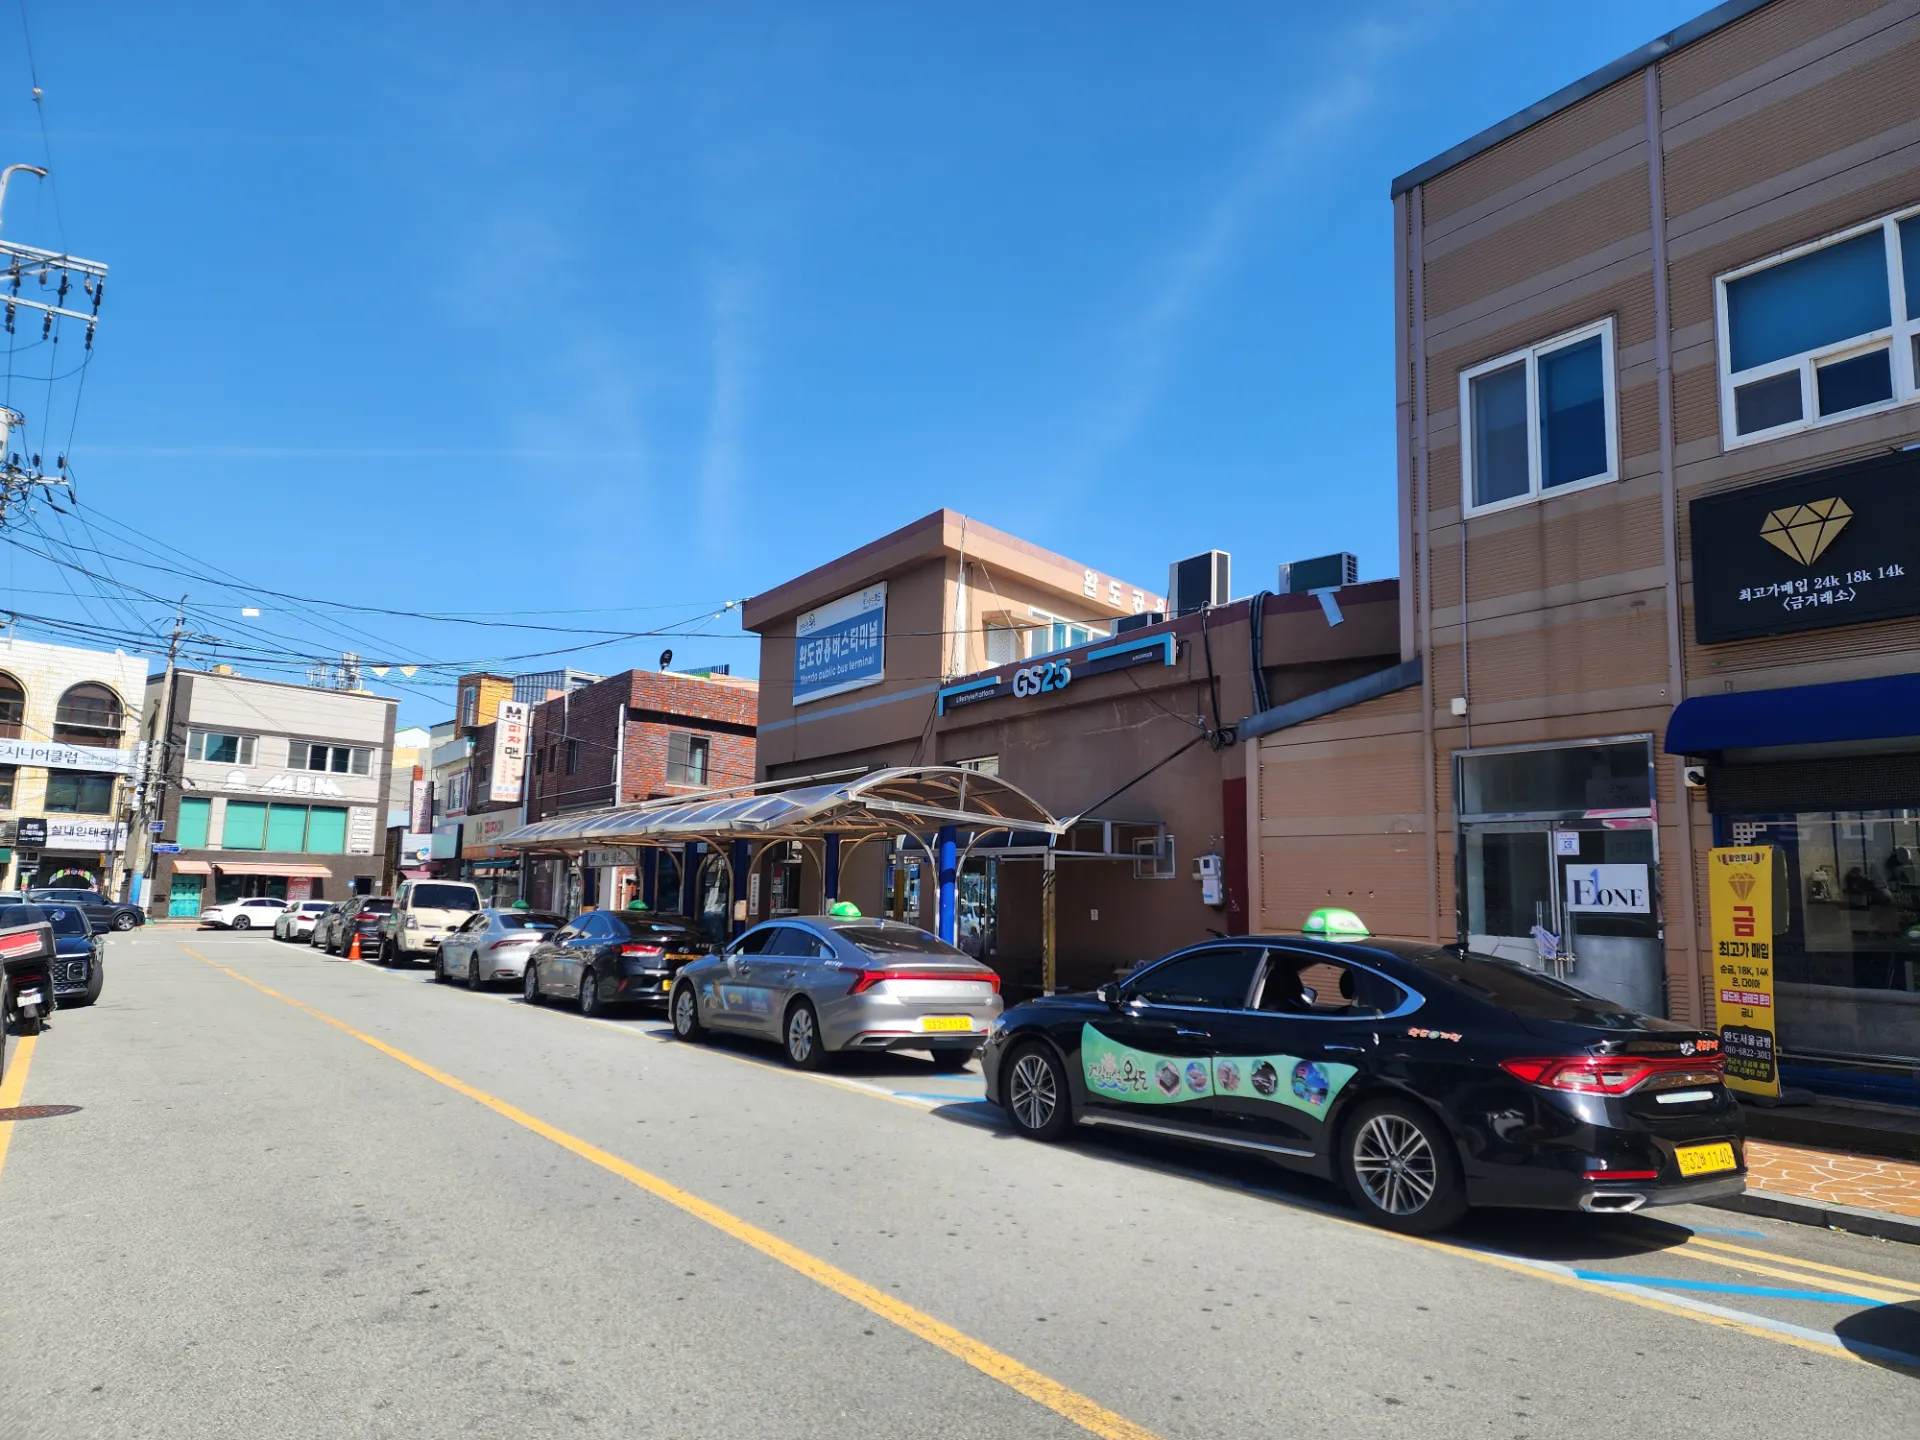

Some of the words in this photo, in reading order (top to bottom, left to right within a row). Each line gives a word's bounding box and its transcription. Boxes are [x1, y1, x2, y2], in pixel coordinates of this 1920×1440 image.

[1739, 579, 1808, 602] 최고가매입
[1814, 575, 1840, 590] 24k
[1845, 570, 1872, 585] 18k
[1878, 564, 1905, 579] 14k
[800, 620, 878, 671] 완도공용버스터미널
[819, 666, 836, 681] public
[837, 665, 848, 675] bus
[849, 654, 875, 671] terminal
[1013, 658, 1071, 698] GS25
[257, 773, 345, 796] MBM
[1732, 906, 1755, 937] 금
[1719, 941, 1749, 958] 최고가
[1751, 942, 1769, 959] 매입
[1756, 967, 1769, 977] 14K
[1742, 979, 1761, 989] 다이아
[1741, 1007, 1754, 1019] 금니
[1723, 1031, 1772, 1049] 완도서울금방
[1725, 1044, 1772, 1060] 010-6822-3013
[1123, 1060, 1149, 1091] 완도
